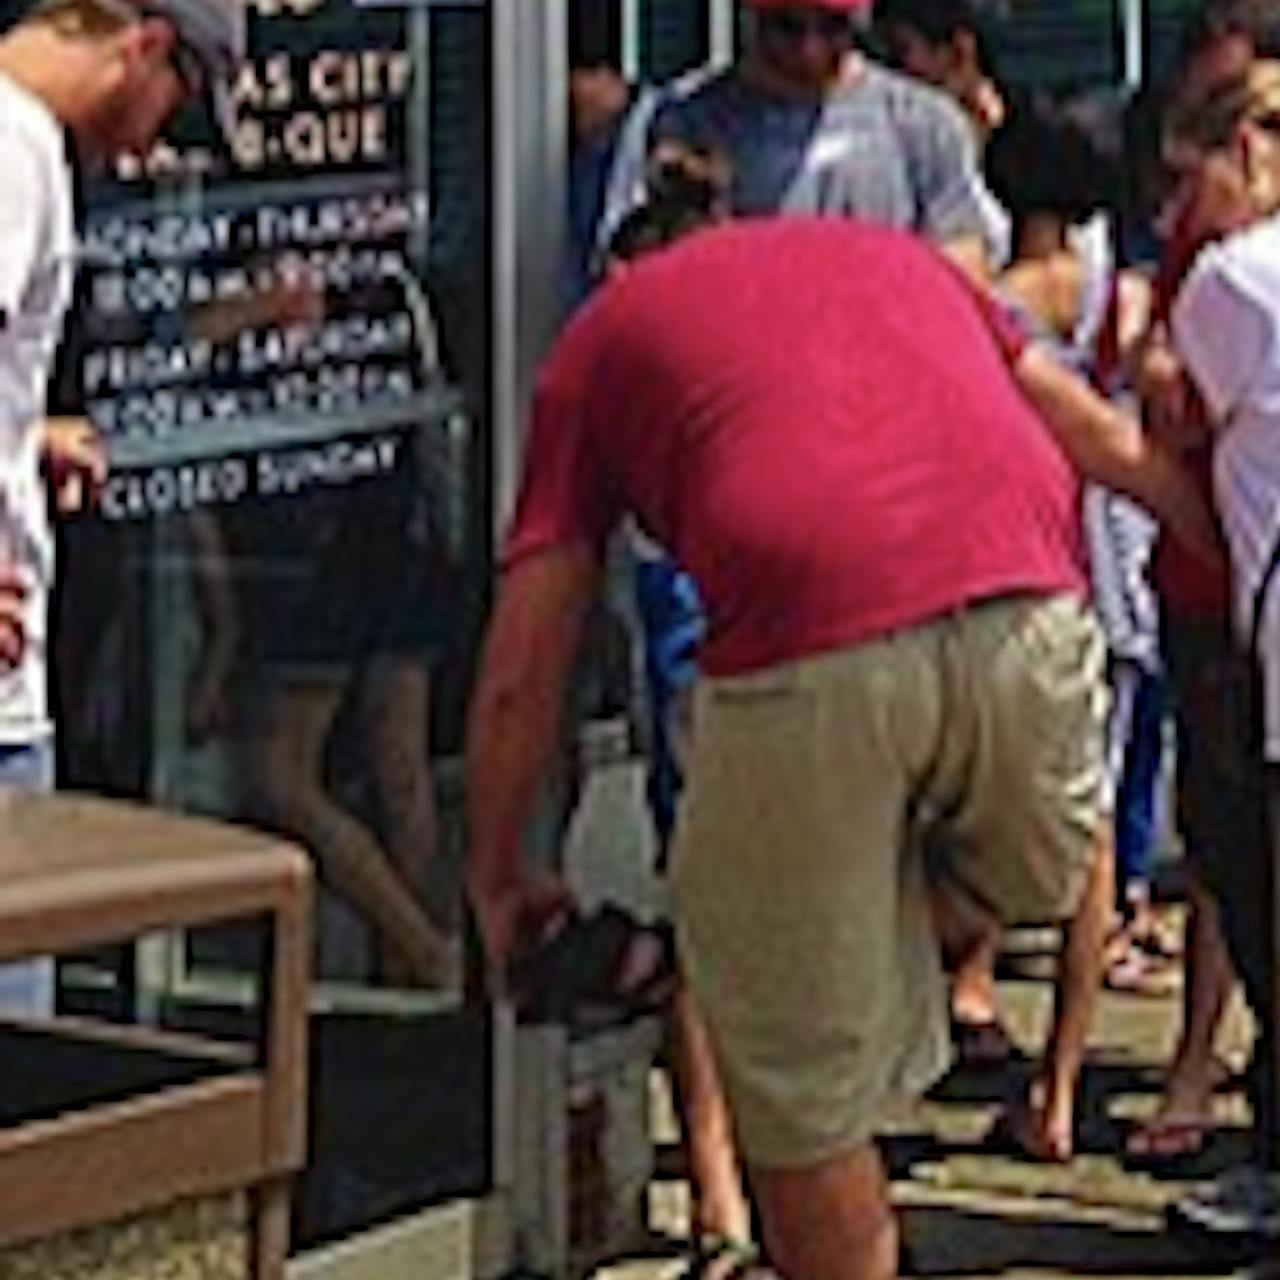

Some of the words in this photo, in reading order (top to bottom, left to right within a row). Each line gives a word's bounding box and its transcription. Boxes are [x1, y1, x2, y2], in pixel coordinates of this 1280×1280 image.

[309, 49, 412, 104] CITY
[101, 458, 248, 519] CLOSED
[256, 438, 400, 495] SUNDAY
